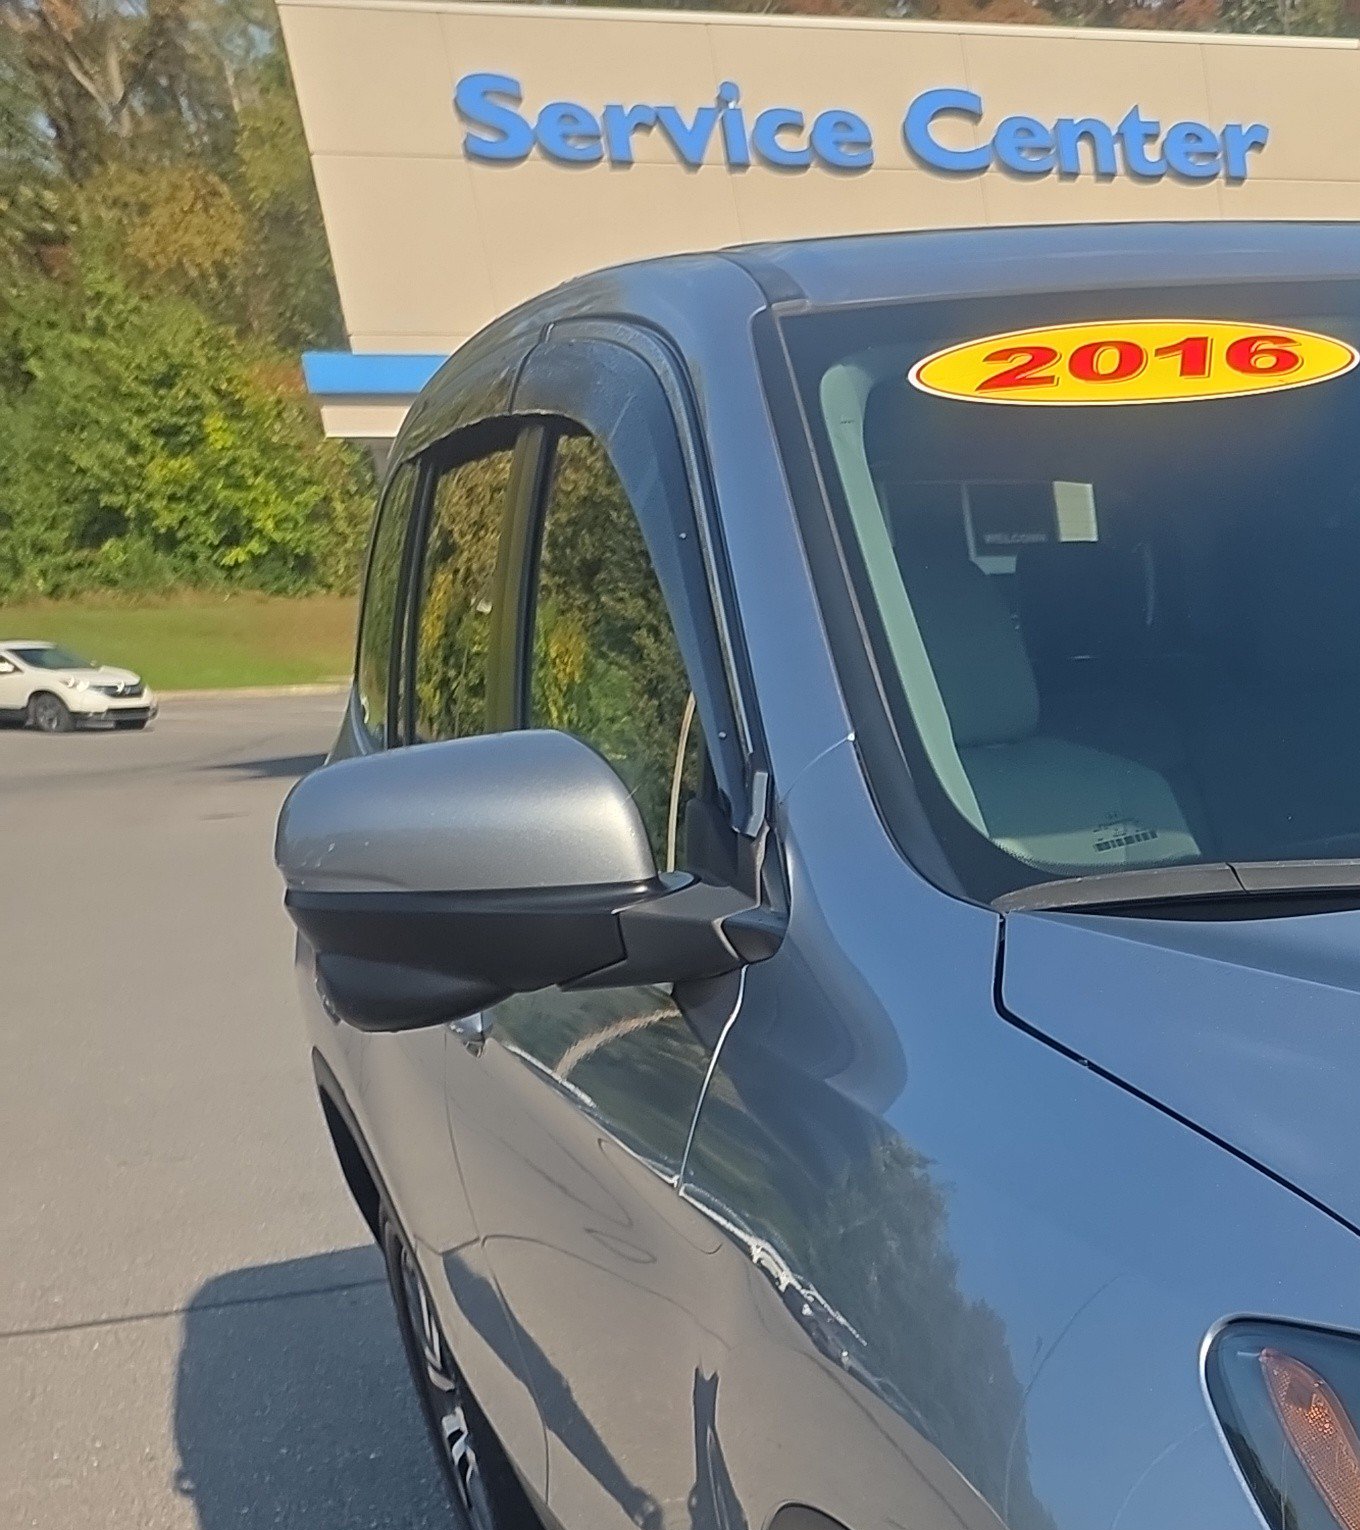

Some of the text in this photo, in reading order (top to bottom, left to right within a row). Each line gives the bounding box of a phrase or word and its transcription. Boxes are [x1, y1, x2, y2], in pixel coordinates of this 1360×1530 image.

[453, 72, 1270, 187] Service Center
[974, 335, 1304, 394] 2016
